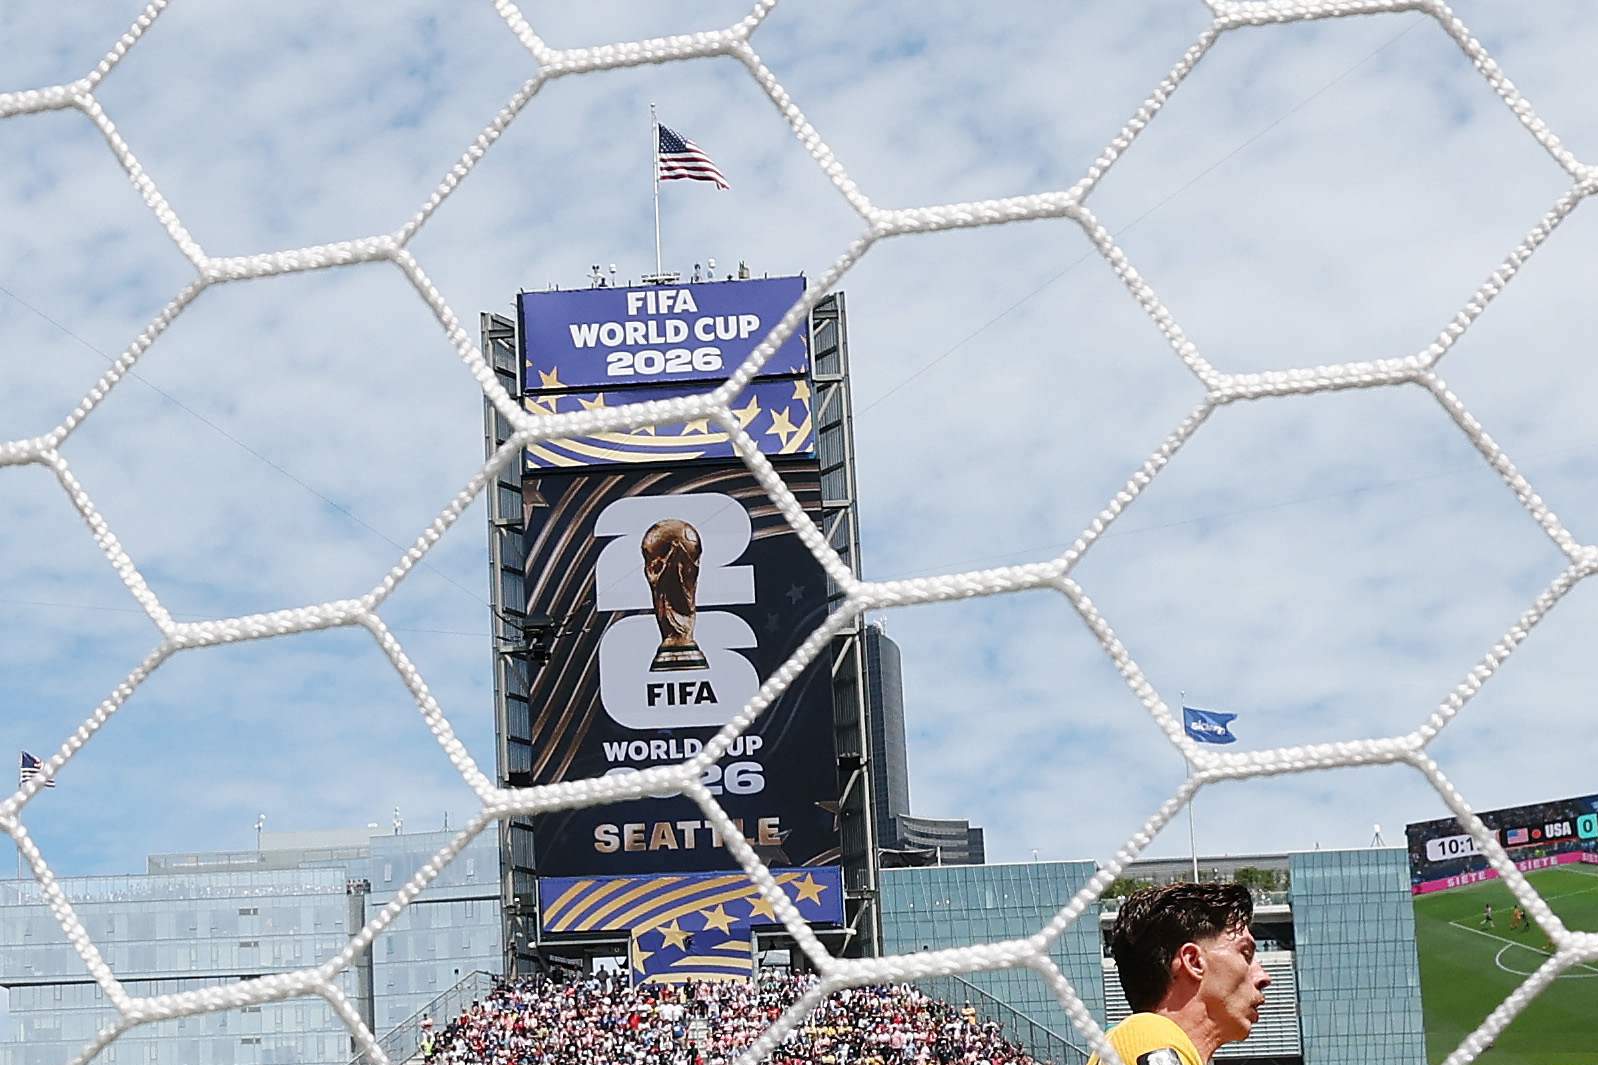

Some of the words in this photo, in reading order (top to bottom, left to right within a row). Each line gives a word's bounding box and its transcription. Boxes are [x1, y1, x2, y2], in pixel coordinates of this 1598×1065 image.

[627, 289, 697, 316] FIFA
[569, 319, 689, 348] WORLD
[694, 315, 760, 342] CUP
[606, 347, 723, 376] 2026
[646, 681, 718, 706] FIFA
[603, 738, 703, 761] WORLD
[708, 735, 763, 757] UP
[605, 761, 765, 799] 26
[1438, 837, 1481, 857] 10:1
[1544, 821, 1572, 839] USA
[1583, 819, 1593, 834] 0
[1519, 855, 1558, 871] SIETE
[1447, 871, 1487, 888] SIETE
